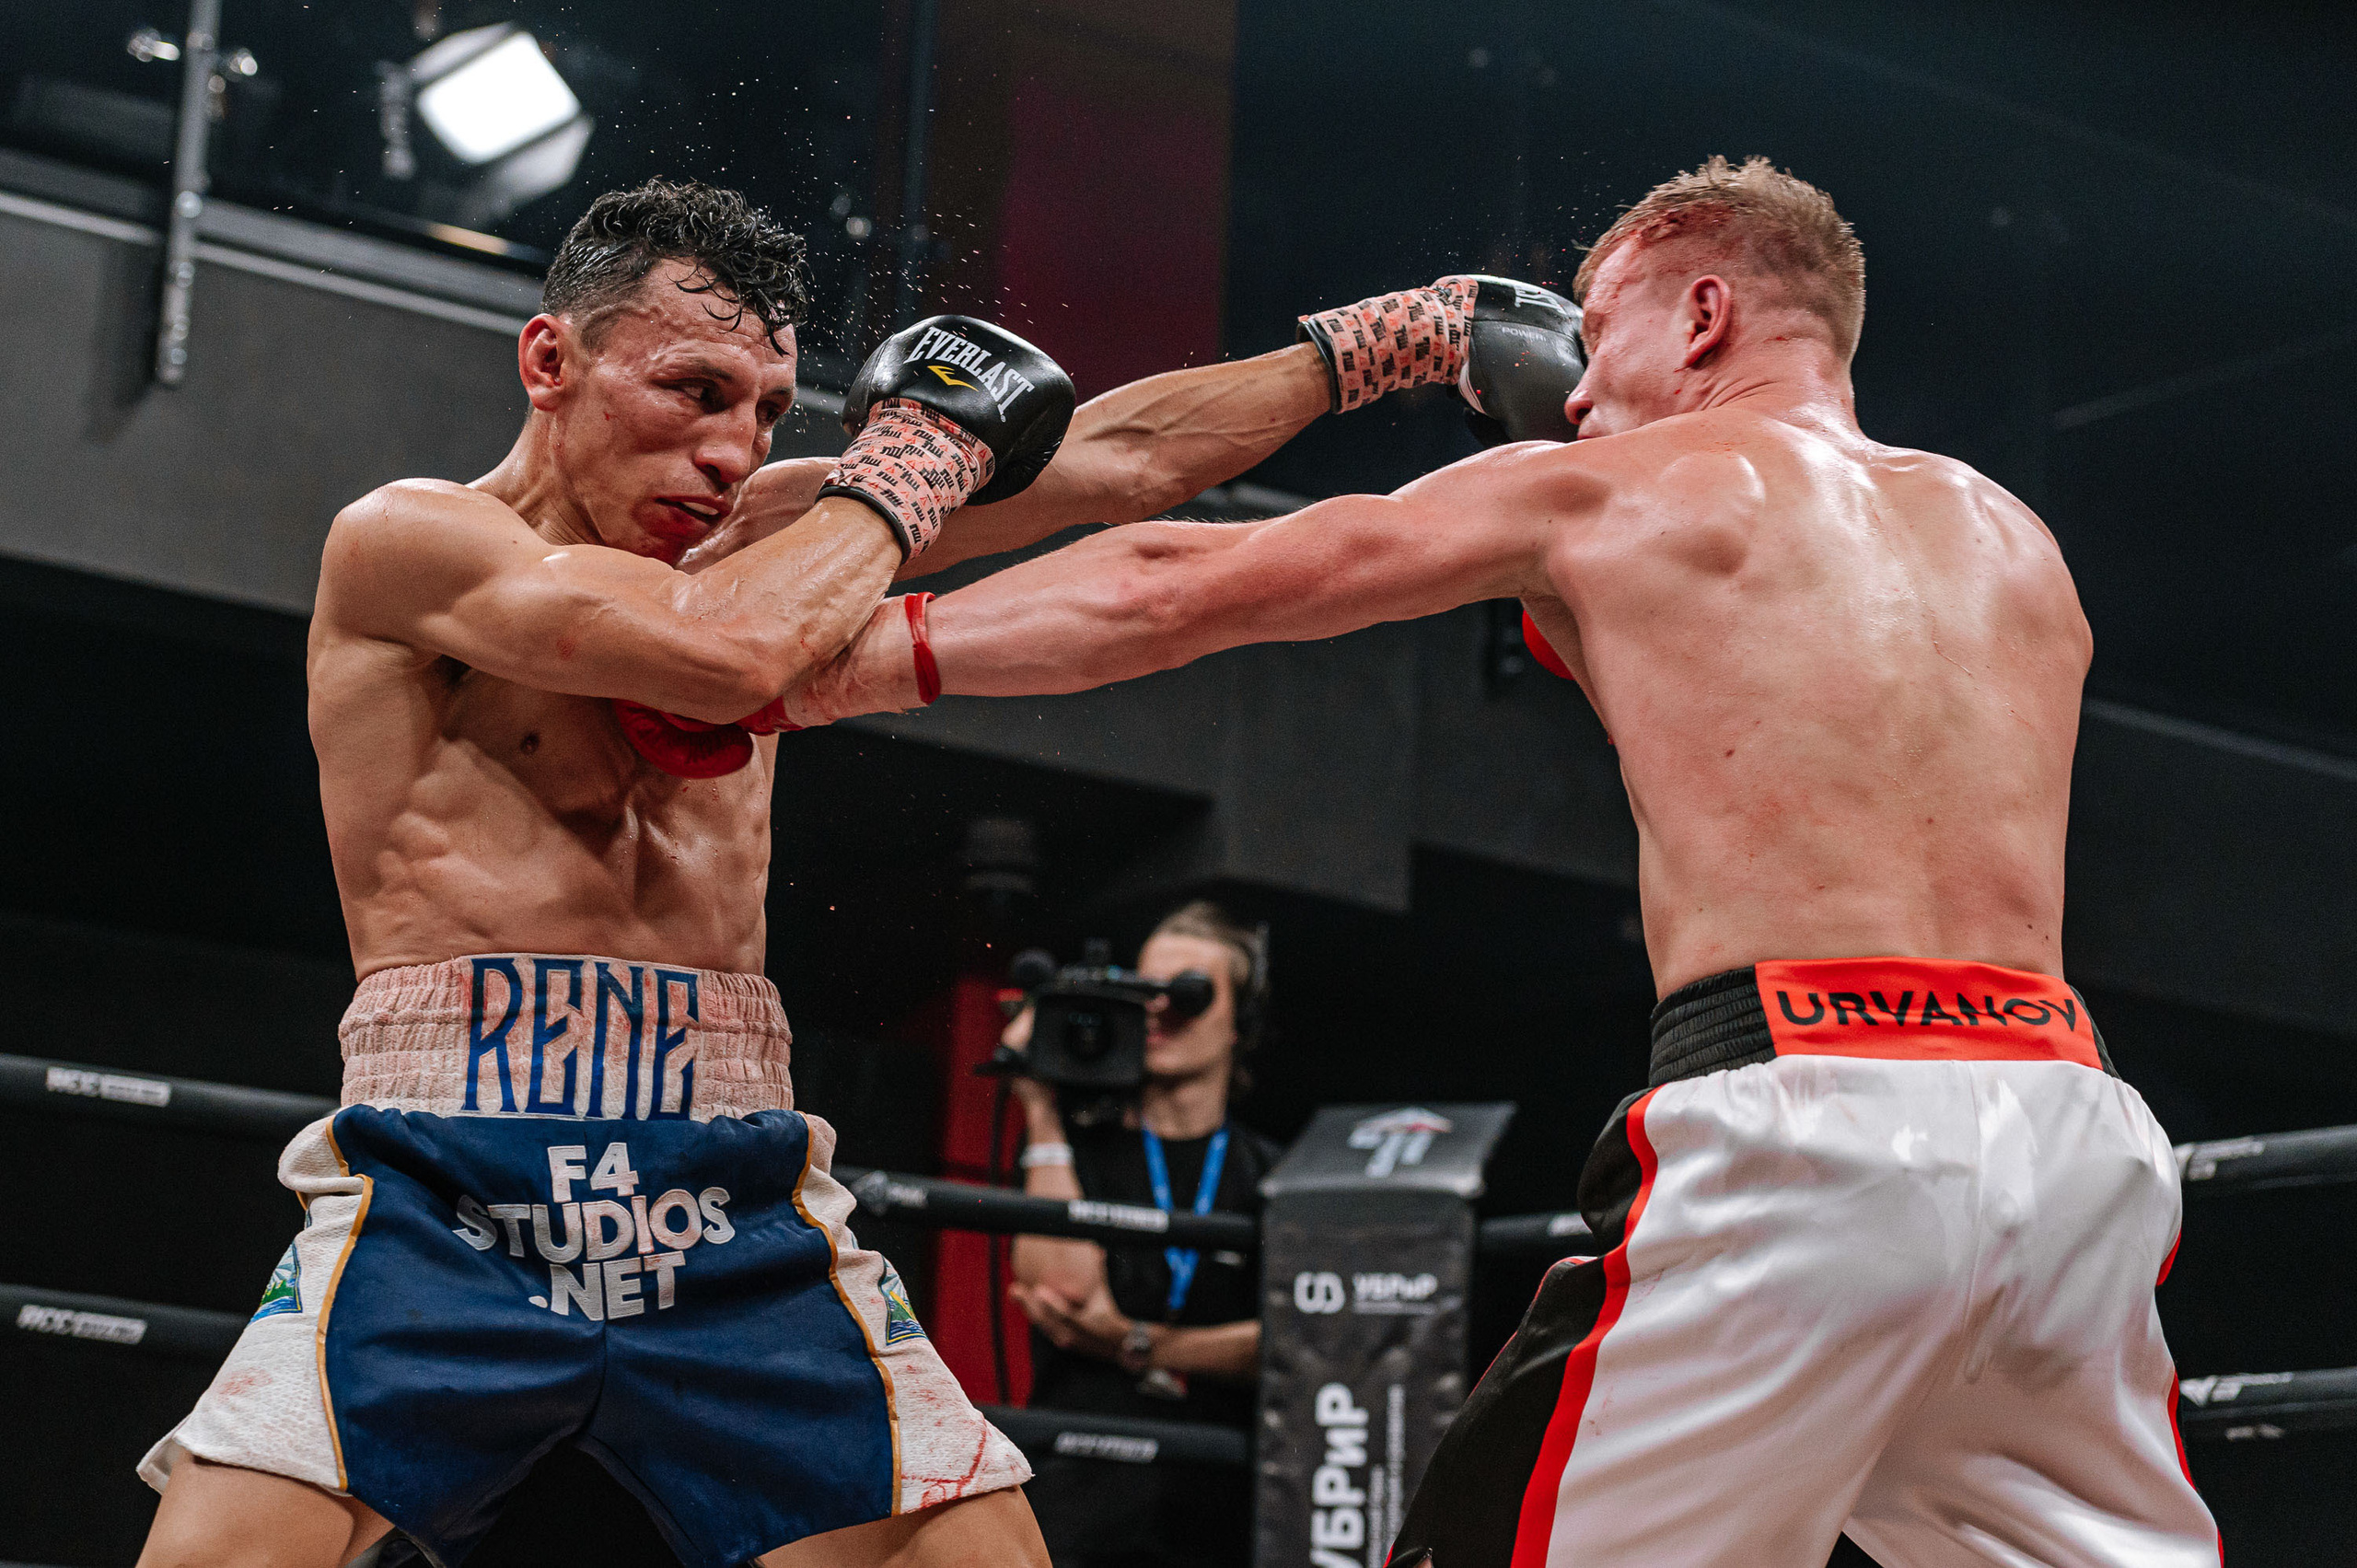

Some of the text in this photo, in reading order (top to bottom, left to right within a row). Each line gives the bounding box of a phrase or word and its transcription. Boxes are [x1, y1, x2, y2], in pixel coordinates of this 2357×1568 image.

[903, 326, 1035, 415] EVERLAST
[461, 957, 700, 1121] RENE
[1775, 989, 2078, 1032] URVANOV
[546, 1142, 640, 1203] F4
[452, 1186, 736, 1264] STUDIOS
[528, 1249, 686, 1322] .NET
